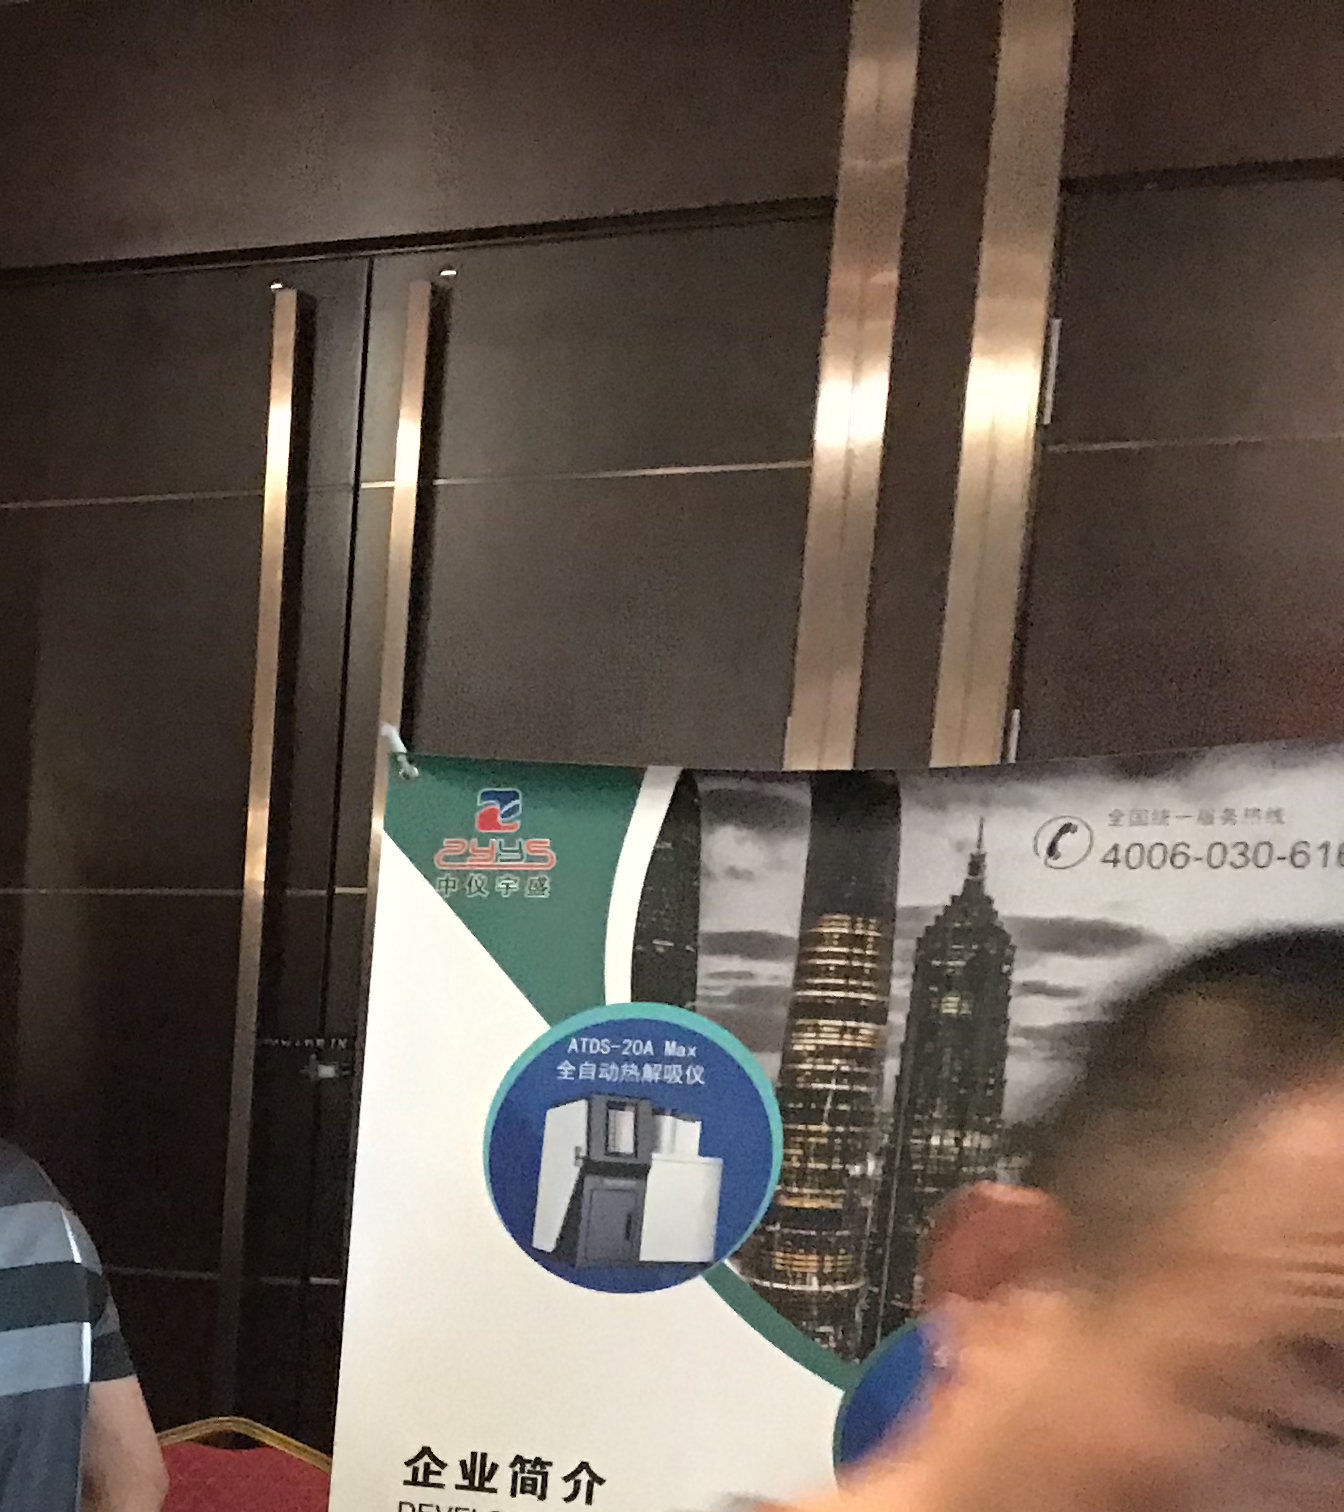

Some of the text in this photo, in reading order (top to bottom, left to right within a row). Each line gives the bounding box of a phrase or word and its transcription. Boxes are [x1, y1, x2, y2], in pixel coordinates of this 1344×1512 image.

[437, 873, 551, 898] 中仪宇盛
[567, 1037, 698, 1058] ATDS-20A Max
[556, 1059, 706, 1085] 全自动热解吸仪
[402, 1445, 607, 1506] 企业简介
